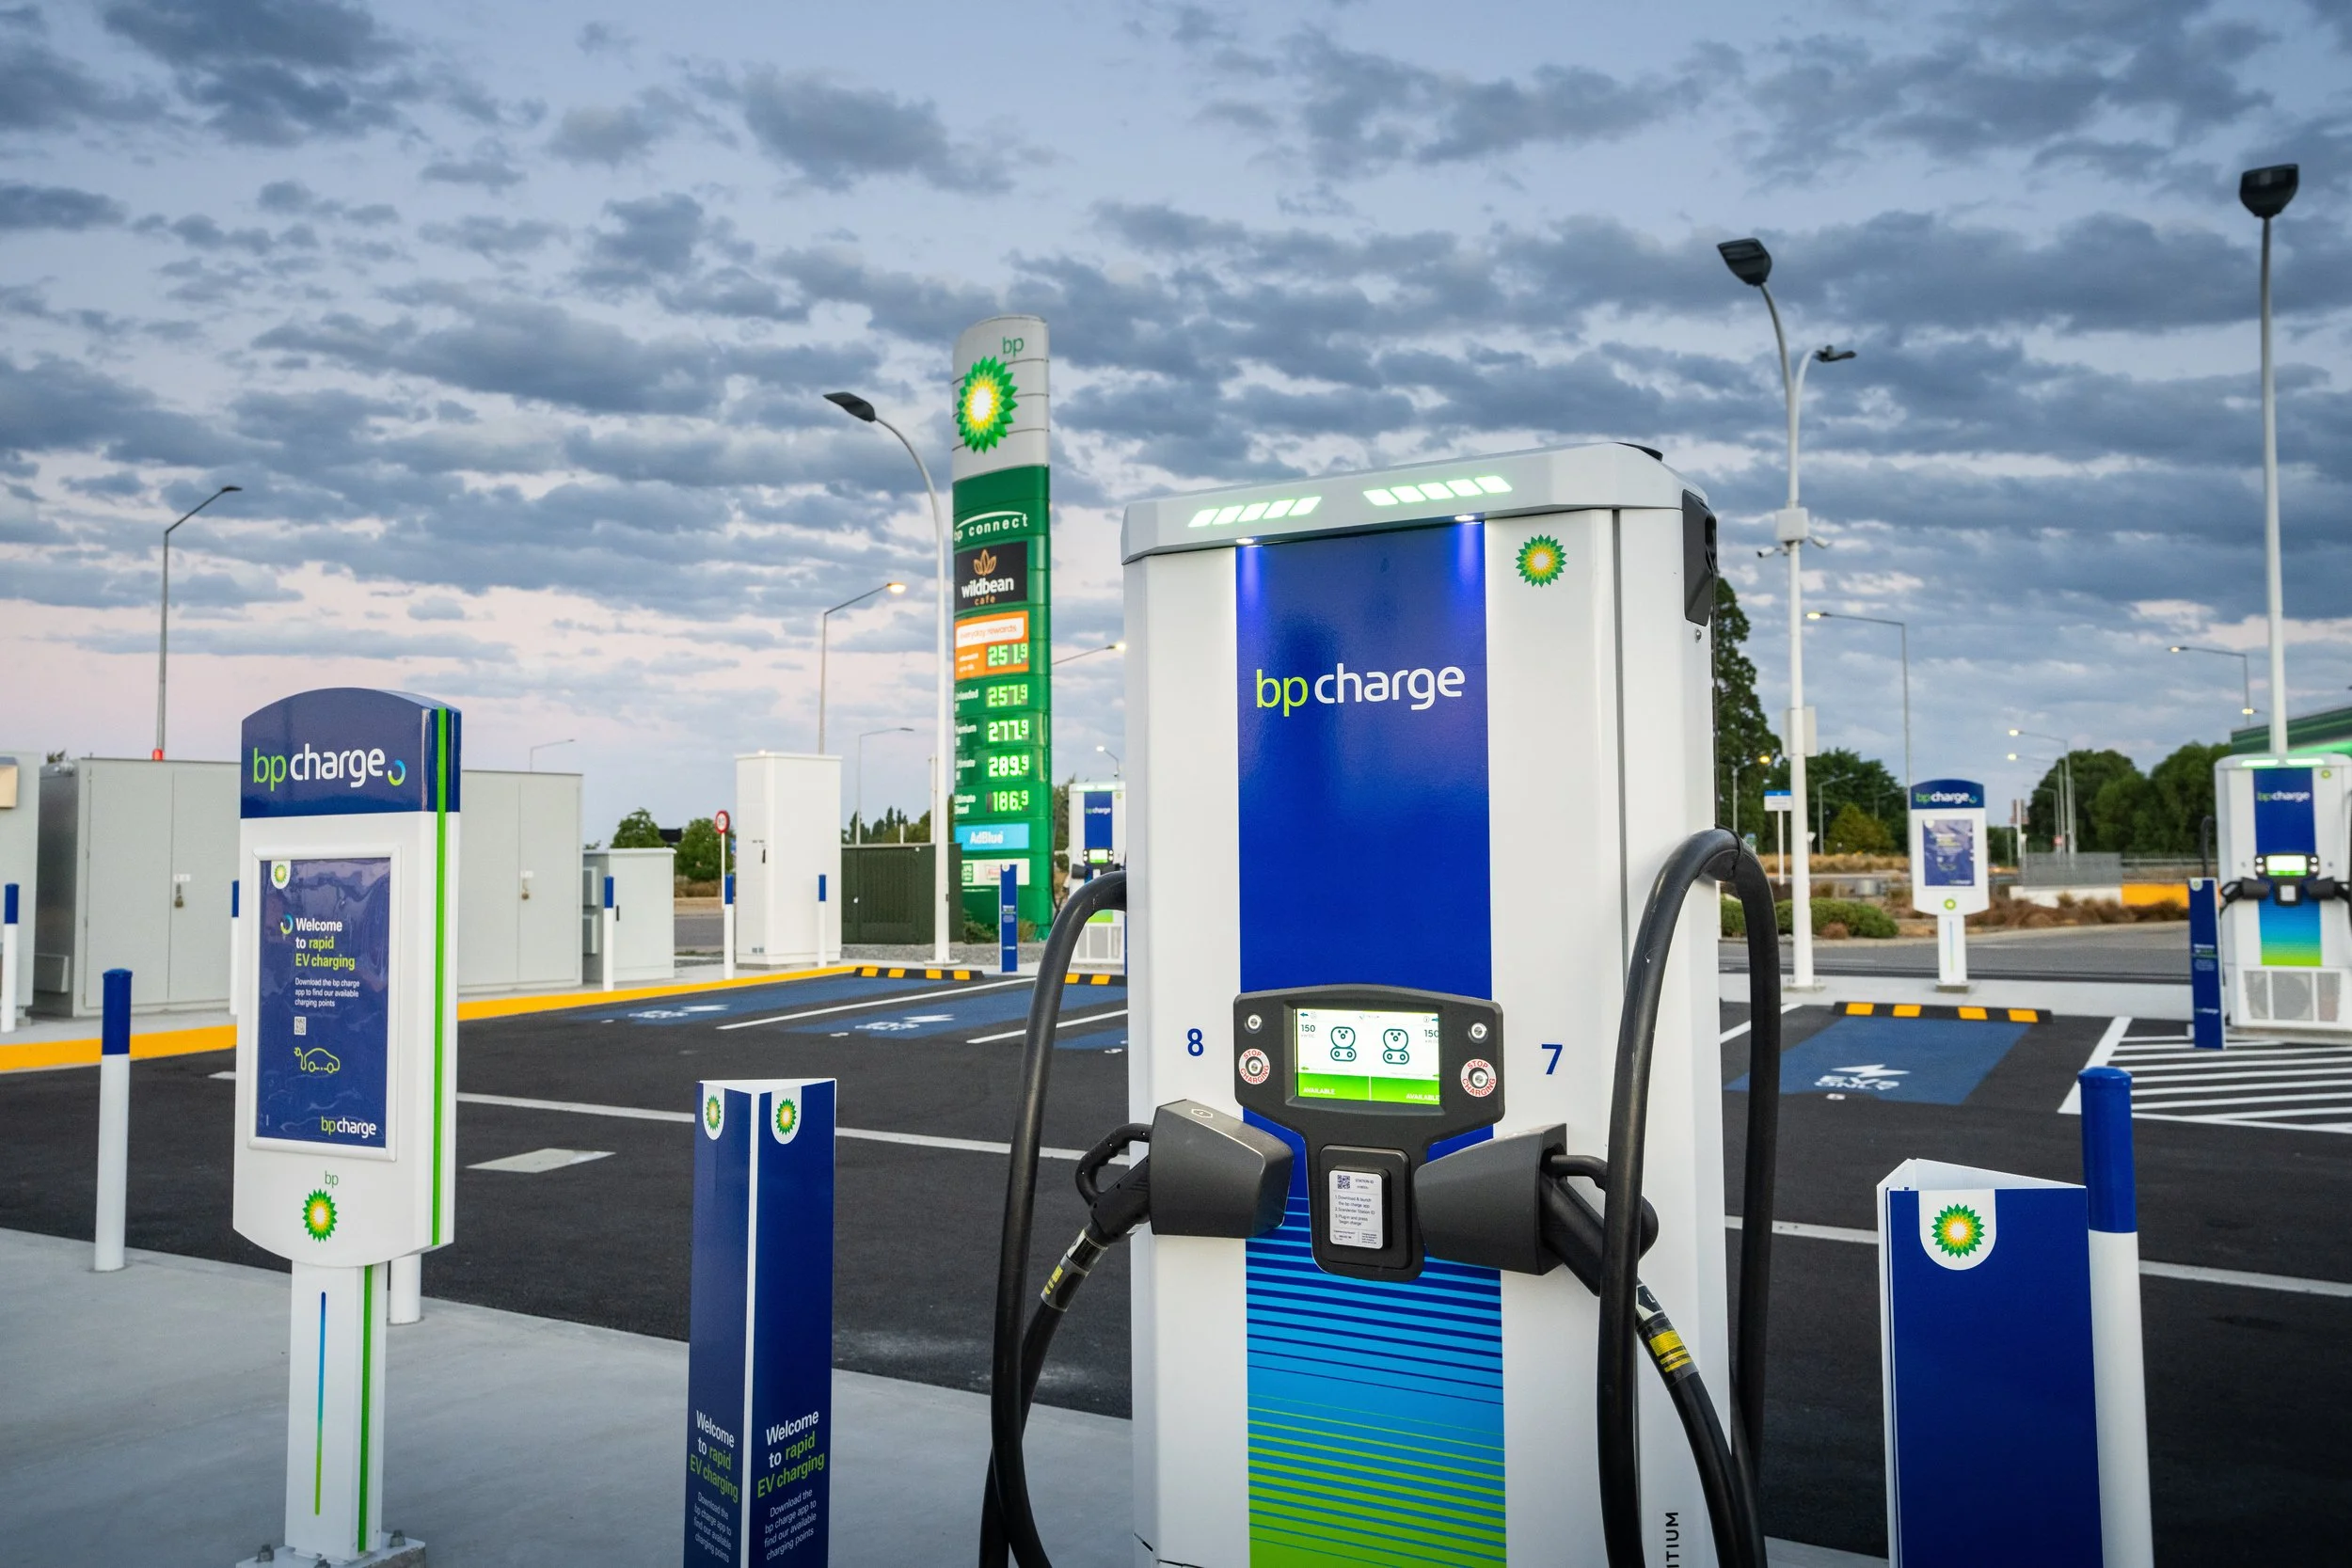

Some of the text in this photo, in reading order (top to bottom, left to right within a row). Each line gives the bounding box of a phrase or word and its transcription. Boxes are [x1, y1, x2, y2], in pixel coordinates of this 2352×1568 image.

[1002, 336, 1025, 356] bp
[968, 513, 1028, 537] connect
[961, 577, 1014, 598] wildbean
[987, 684, 1028, 707] 257.9
[988, 719, 1029, 743] 277.9
[988, 754, 1029, 778] 289.9
[993, 789, 1029, 812] 186.9
[295, 918, 343, 932] Welcome
[295, 936, 335, 952] to rapid
[295, 953, 356, 972] EV charging
[294, 977, 360, 988] Download the bp charge
[312, 989, 323, 997] find
[334, 990, 358, 998] available
[294, 999, 335, 1008] charging points
[1301, 1024, 1316, 1033] 150
[1186, 1028, 1204, 1057] 8
[1243, 1050, 1262, 1060] STOP
[1467, 1060, 1488, 1069] STOP
[1540, 1043, 1564, 1075] 7
[1240, 1065, 1269, 1084] CHARGING
[1303, 1086, 1336, 1095] AVAILABLE
[1406, 1093, 1439, 1101] AVAILABLE
[1462, 1078, 1496, 1096] CHARGING
[325, 1170, 339, 1188] bp
[695, 1410, 735, 1449] Welcome
[766, 1411, 819, 1447] Welcome
[697, 1437, 731, 1471] to rapid
[769, 1431, 816, 1468] to rapid
[690, 1453, 739, 1504] EV charging
[757, 1453, 825, 1498] EV charging
[697, 1491, 729, 1520] Download the
[770, 1489, 813, 1518] Download the
[693, 1503, 732, 1536] bp charge app to
[764, 1500, 817, 1534] bp charge app to
[693, 1516, 703, 1530] find
[711, 1530, 732, 1550] available
[764, 1512, 817, 1548] find our available
[694, 1533, 730, 1563] charging points
[766, 1528, 814, 1561] charging points
